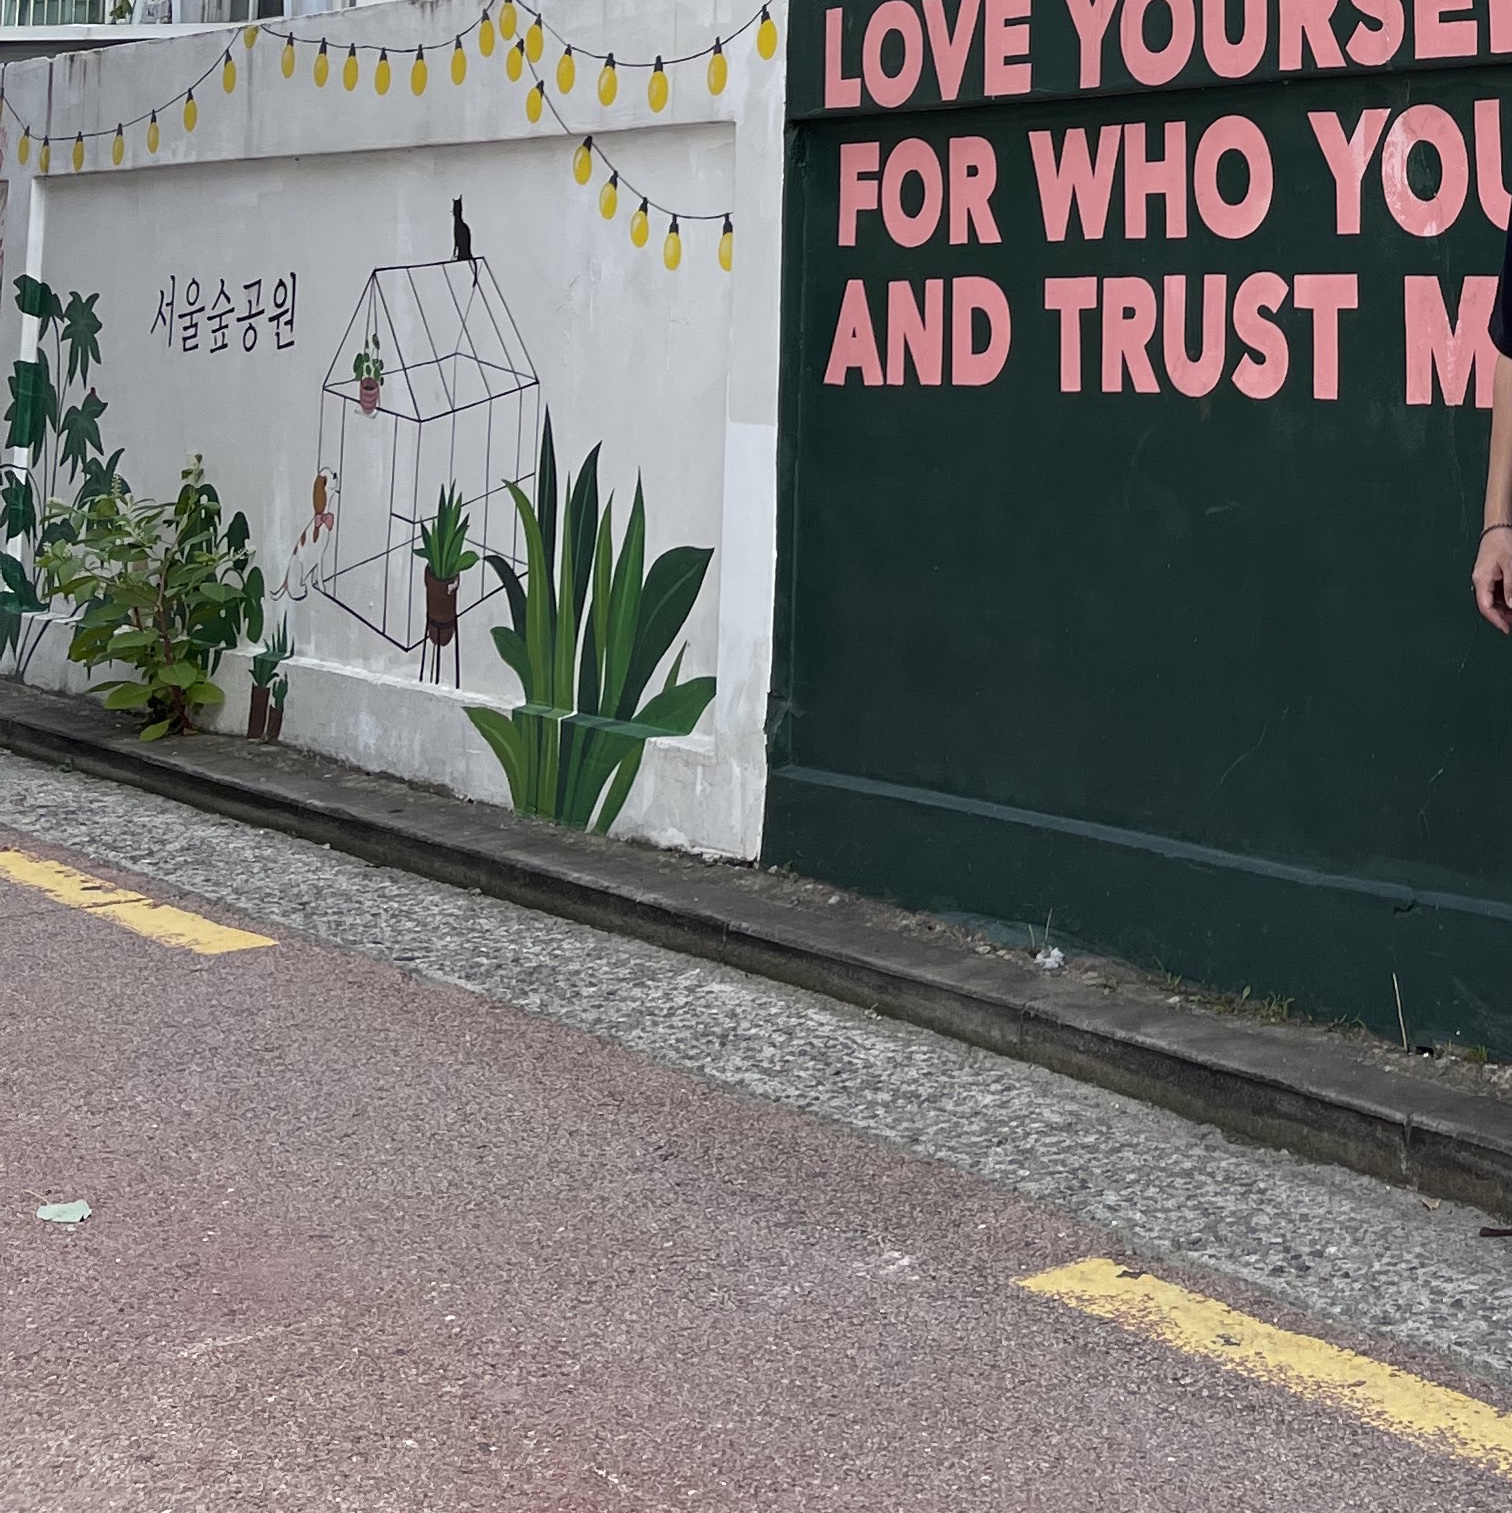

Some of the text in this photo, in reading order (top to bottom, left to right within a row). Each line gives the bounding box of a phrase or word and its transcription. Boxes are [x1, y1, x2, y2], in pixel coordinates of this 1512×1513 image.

[838, 138, 1001, 248] FOR
[1029, 109, 1274, 242] WHO
[149, 271, 297, 354] 서울숲공원
[824, 276, 1011, 386] AND
[1044, 272, 1359, 400] TRUST
